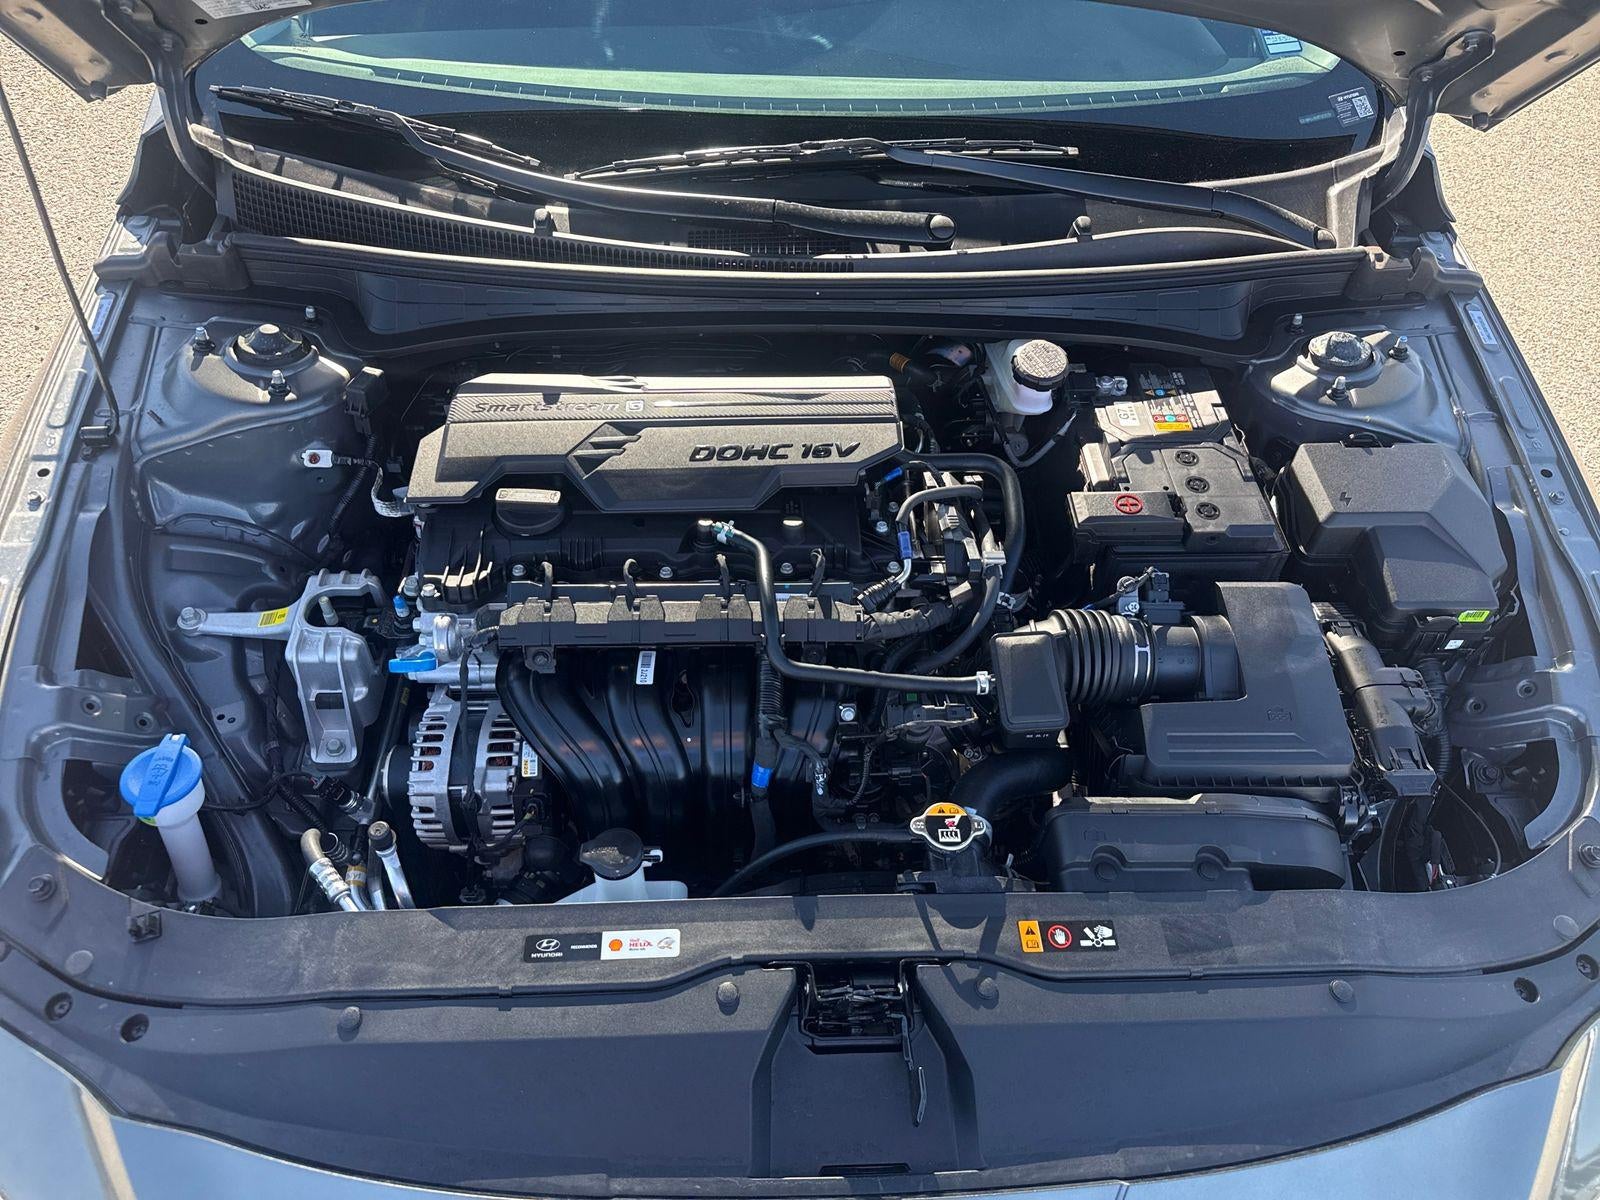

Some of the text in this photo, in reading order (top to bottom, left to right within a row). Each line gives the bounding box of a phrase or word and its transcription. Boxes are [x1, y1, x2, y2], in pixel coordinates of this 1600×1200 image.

[472, 401, 620, 413] Smartstream
[689, 442, 861, 462] DOHC 16V
